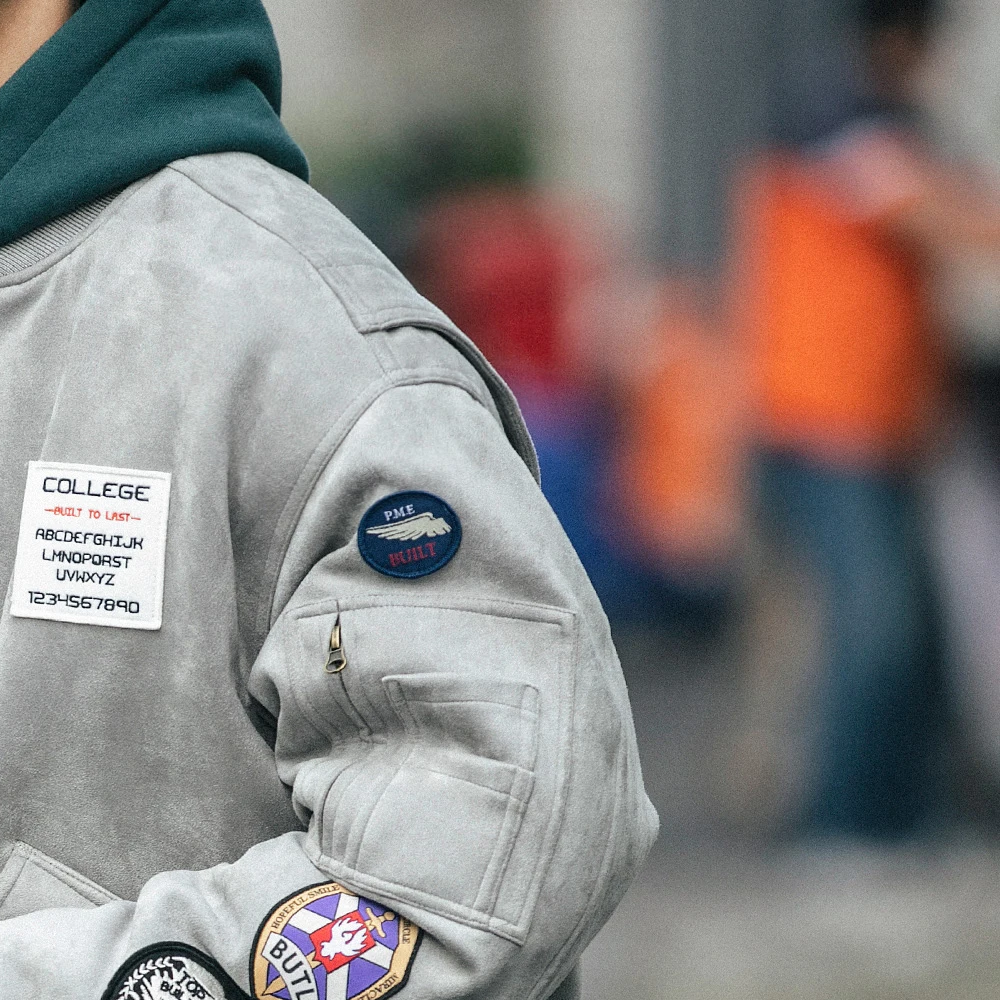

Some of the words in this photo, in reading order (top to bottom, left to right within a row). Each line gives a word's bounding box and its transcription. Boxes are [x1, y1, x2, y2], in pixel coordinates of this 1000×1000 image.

[42, 476, 151, 502] COLLEGE
[88, 508, 101, 519] TO
[35, 528, 144, 550] ABCDEFGHIJK
[42, 548, 132, 569] LMNOPQRST
[388, 541, 436, 568] BUILT
[56, 568, 116, 586] UVWXYZ
[28, 590, 140, 614] 1234567890
[271, 896, 308, 929] HOPEFUL
[308, 884, 340, 899] SMILE
[175, 970, 206, 1000] TOP
